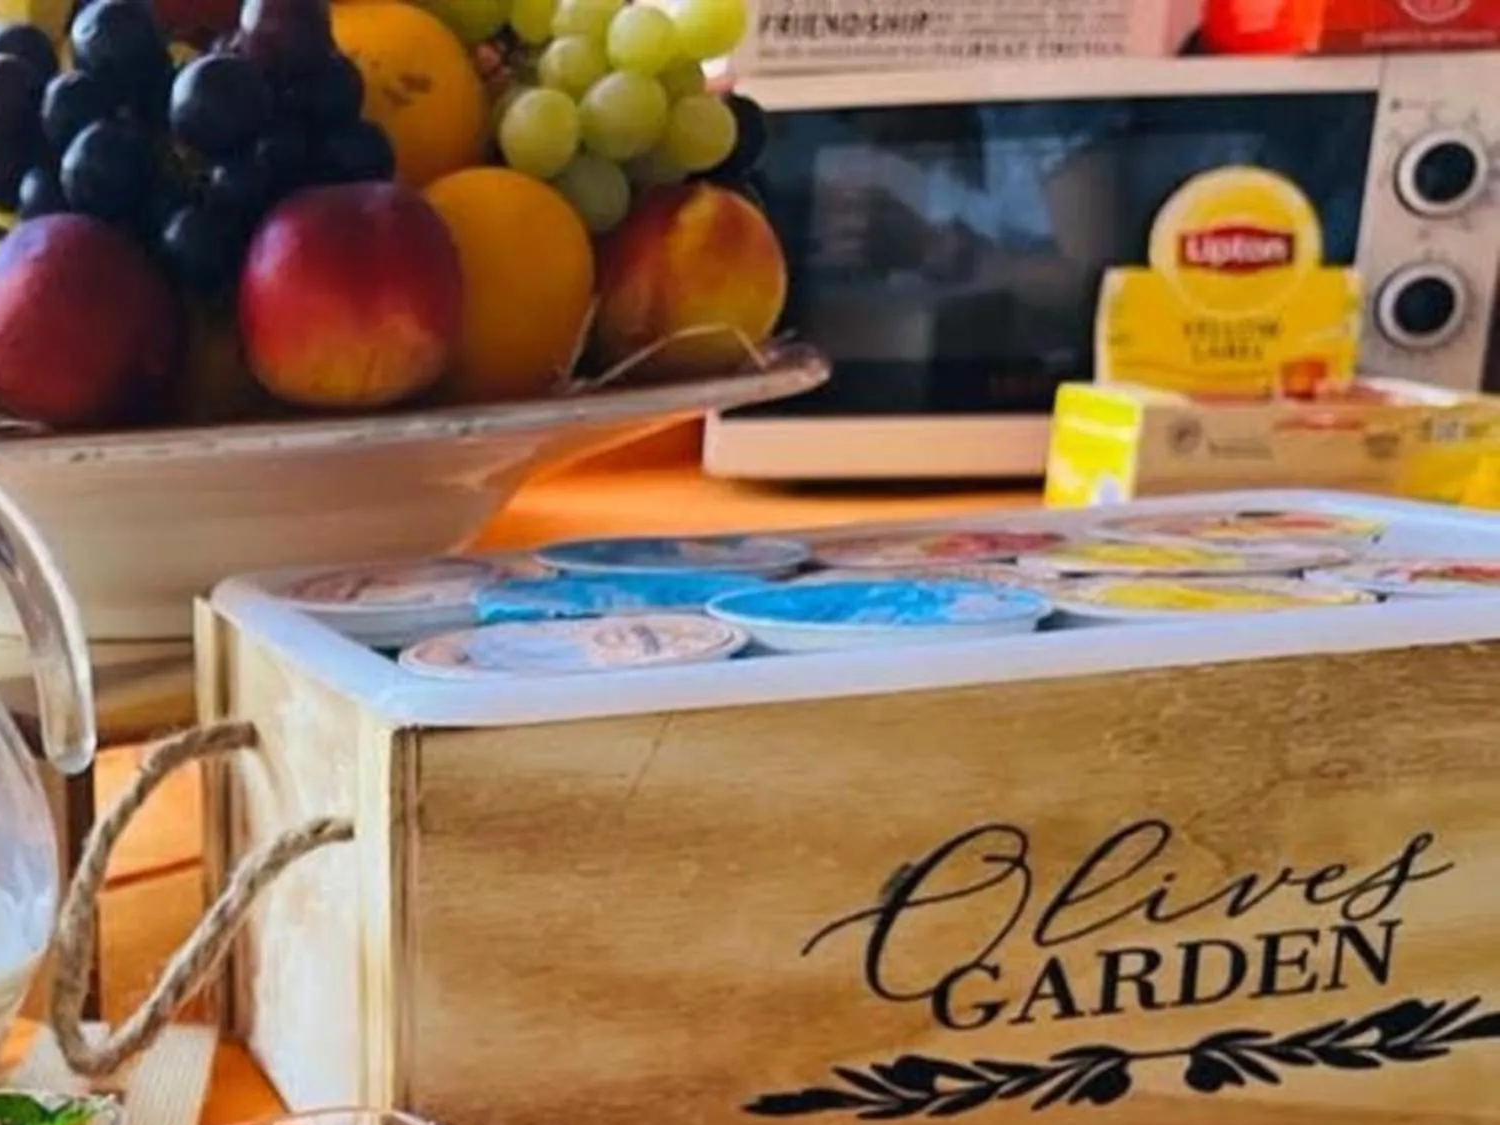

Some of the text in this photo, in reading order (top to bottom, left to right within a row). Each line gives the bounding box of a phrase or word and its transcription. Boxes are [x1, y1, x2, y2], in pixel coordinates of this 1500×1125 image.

[758, 12, 929, 38] FRIENDSHIP
[1184, 234, 1288, 266] Lipton
[1182, 318, 1281, 341] YELLOW
[1191, 343, 1265, 363] LABEL
[801, 820, 1455, 1002] Olives
[930, 921, 1402, 1030] GARDEN
